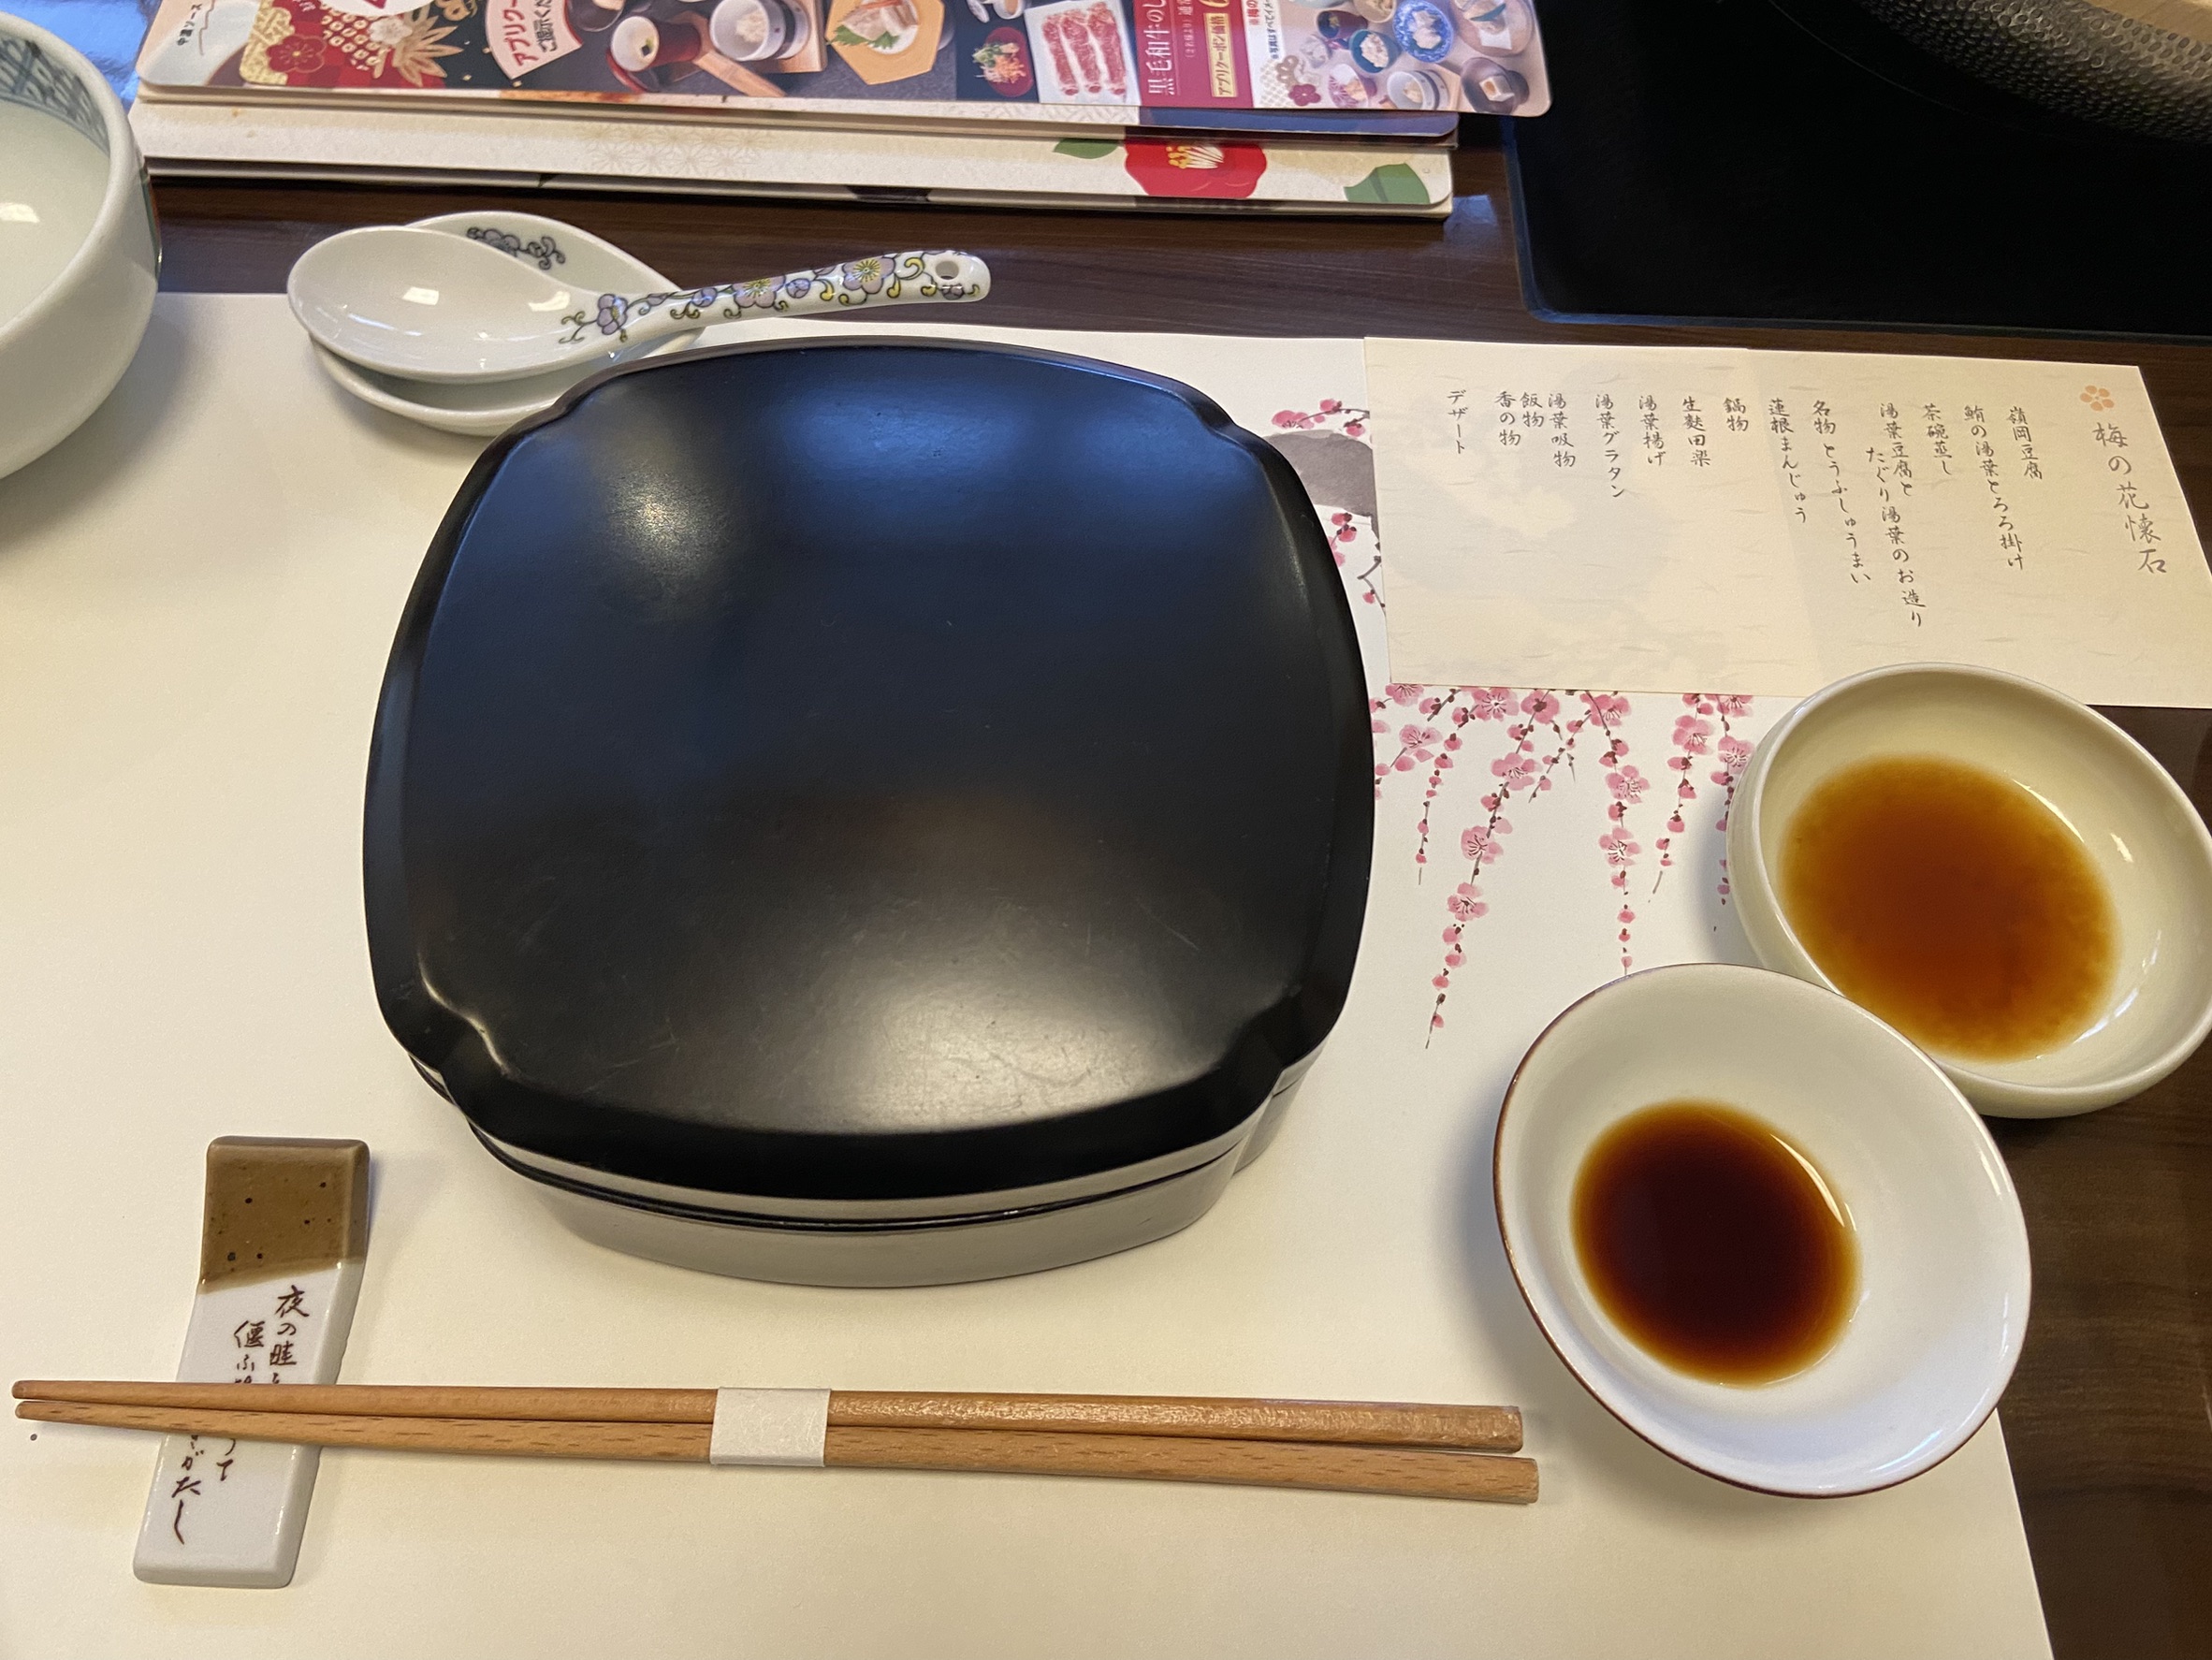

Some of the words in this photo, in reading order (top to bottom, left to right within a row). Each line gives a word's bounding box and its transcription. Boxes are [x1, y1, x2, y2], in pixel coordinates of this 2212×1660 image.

[1447, 389, 1469, 455] デザート
[1494, 390, 1521, 446] 香の物
[1519, 391, 1544, 428] 飯物
[1547, 392, 1576, 468] 湯葉吸物
[1594, 393, 1625, 498] 湯葉グラタン
[1637, 395, 1666, 466] 湯葉揚げ
[1723, 397, 1750, 432] 鍋物
[1922, 402, 1953, 475] 茶碗蒸し
[1768, 397, 1807, 524] 蓮根まんじゅう
[1879, 402, 1913, 497] 湯葉豆腐と
[1963, 404, 2024, 571] 鮪の湯葉とろろ掛け
[2091, 421, 2168, 575] 梅の花懐石
[1865, 446, 1927, 628] たぐり湯葉のお造り
